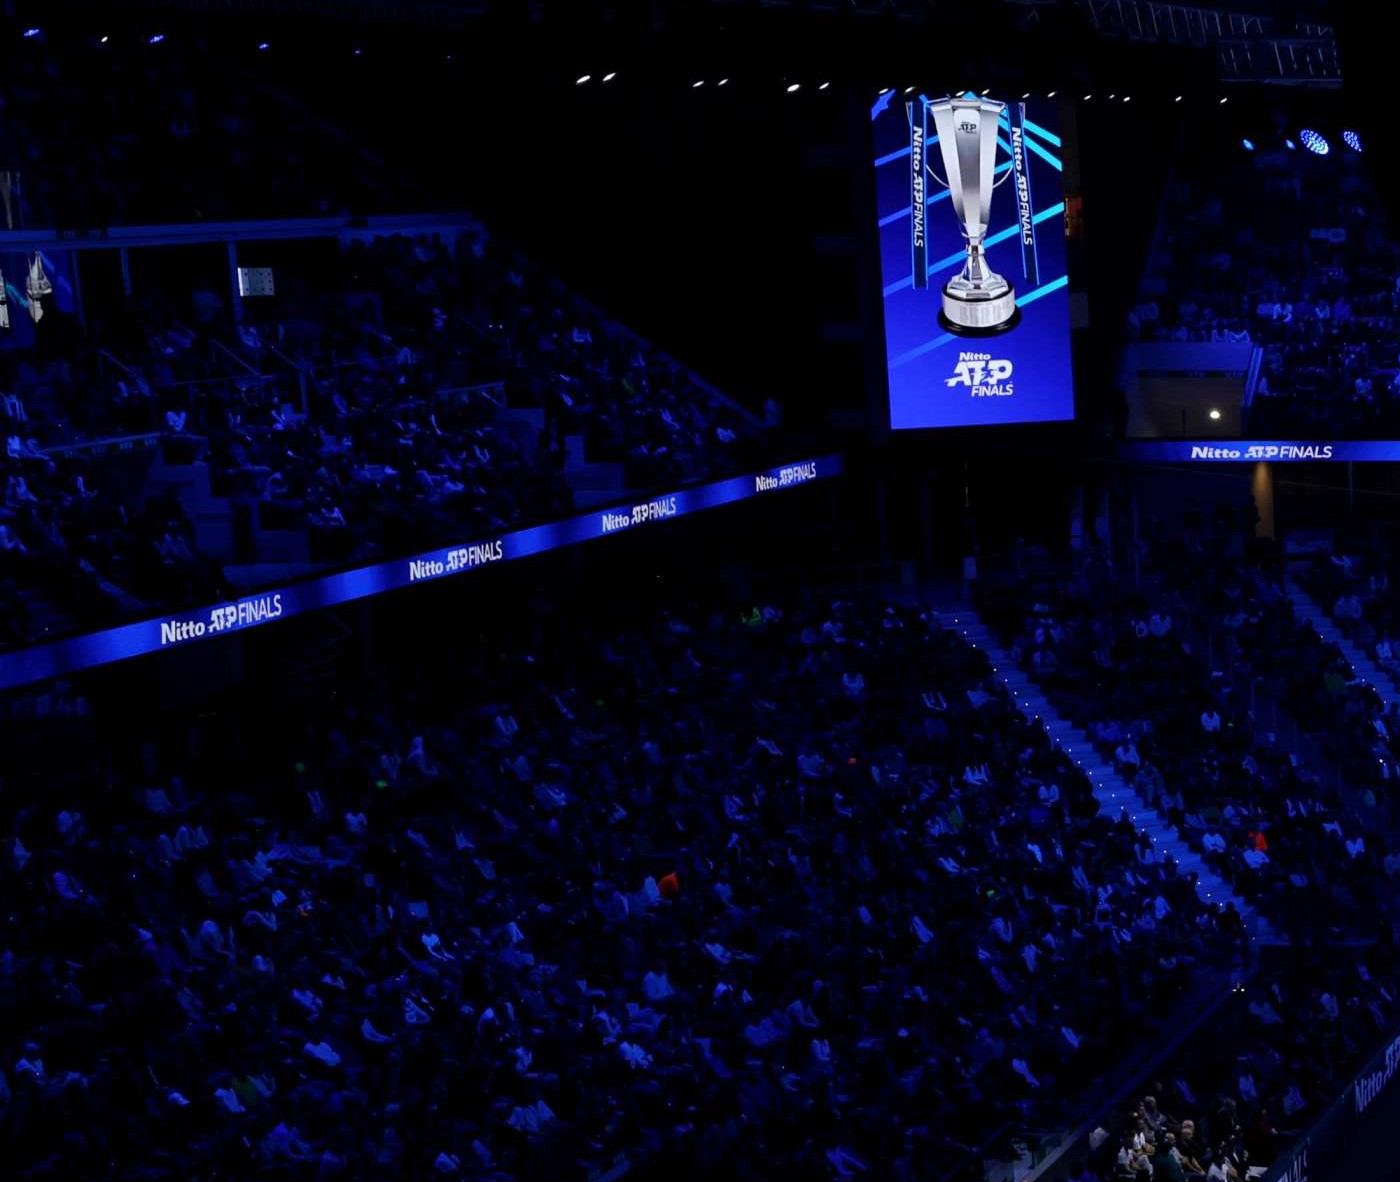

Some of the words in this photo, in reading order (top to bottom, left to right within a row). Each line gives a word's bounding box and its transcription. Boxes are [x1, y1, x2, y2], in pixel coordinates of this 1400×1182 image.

[913, 127, 922, 170] Nitto
[1012, 127, 1022, 170] Nitto
[1019, 201, 1033, 246] FINALS
[914, 201, 923, 247] FINALS
[944, 360, 1013, 387] ATP
[959, 352, 991, 361] Nitto
[971, 384, 1013, 397] FINALS
[1192, 447, 1240, 458] Nitto
[1280, 446, 1332, 458] FINALS
[755, 475, 778, 492] Nitto
[794, 462, 817, 481] FINALS
[602, 513, 629, 532] Nitto
[649, 497, 677, 519] FINALS
[409, 561, 443, 580] Nitto
[468, 541, 503, 564] FINALS
[161, 618, 206, 644] Nitto
[238, 595, 282, 622] FINALS
